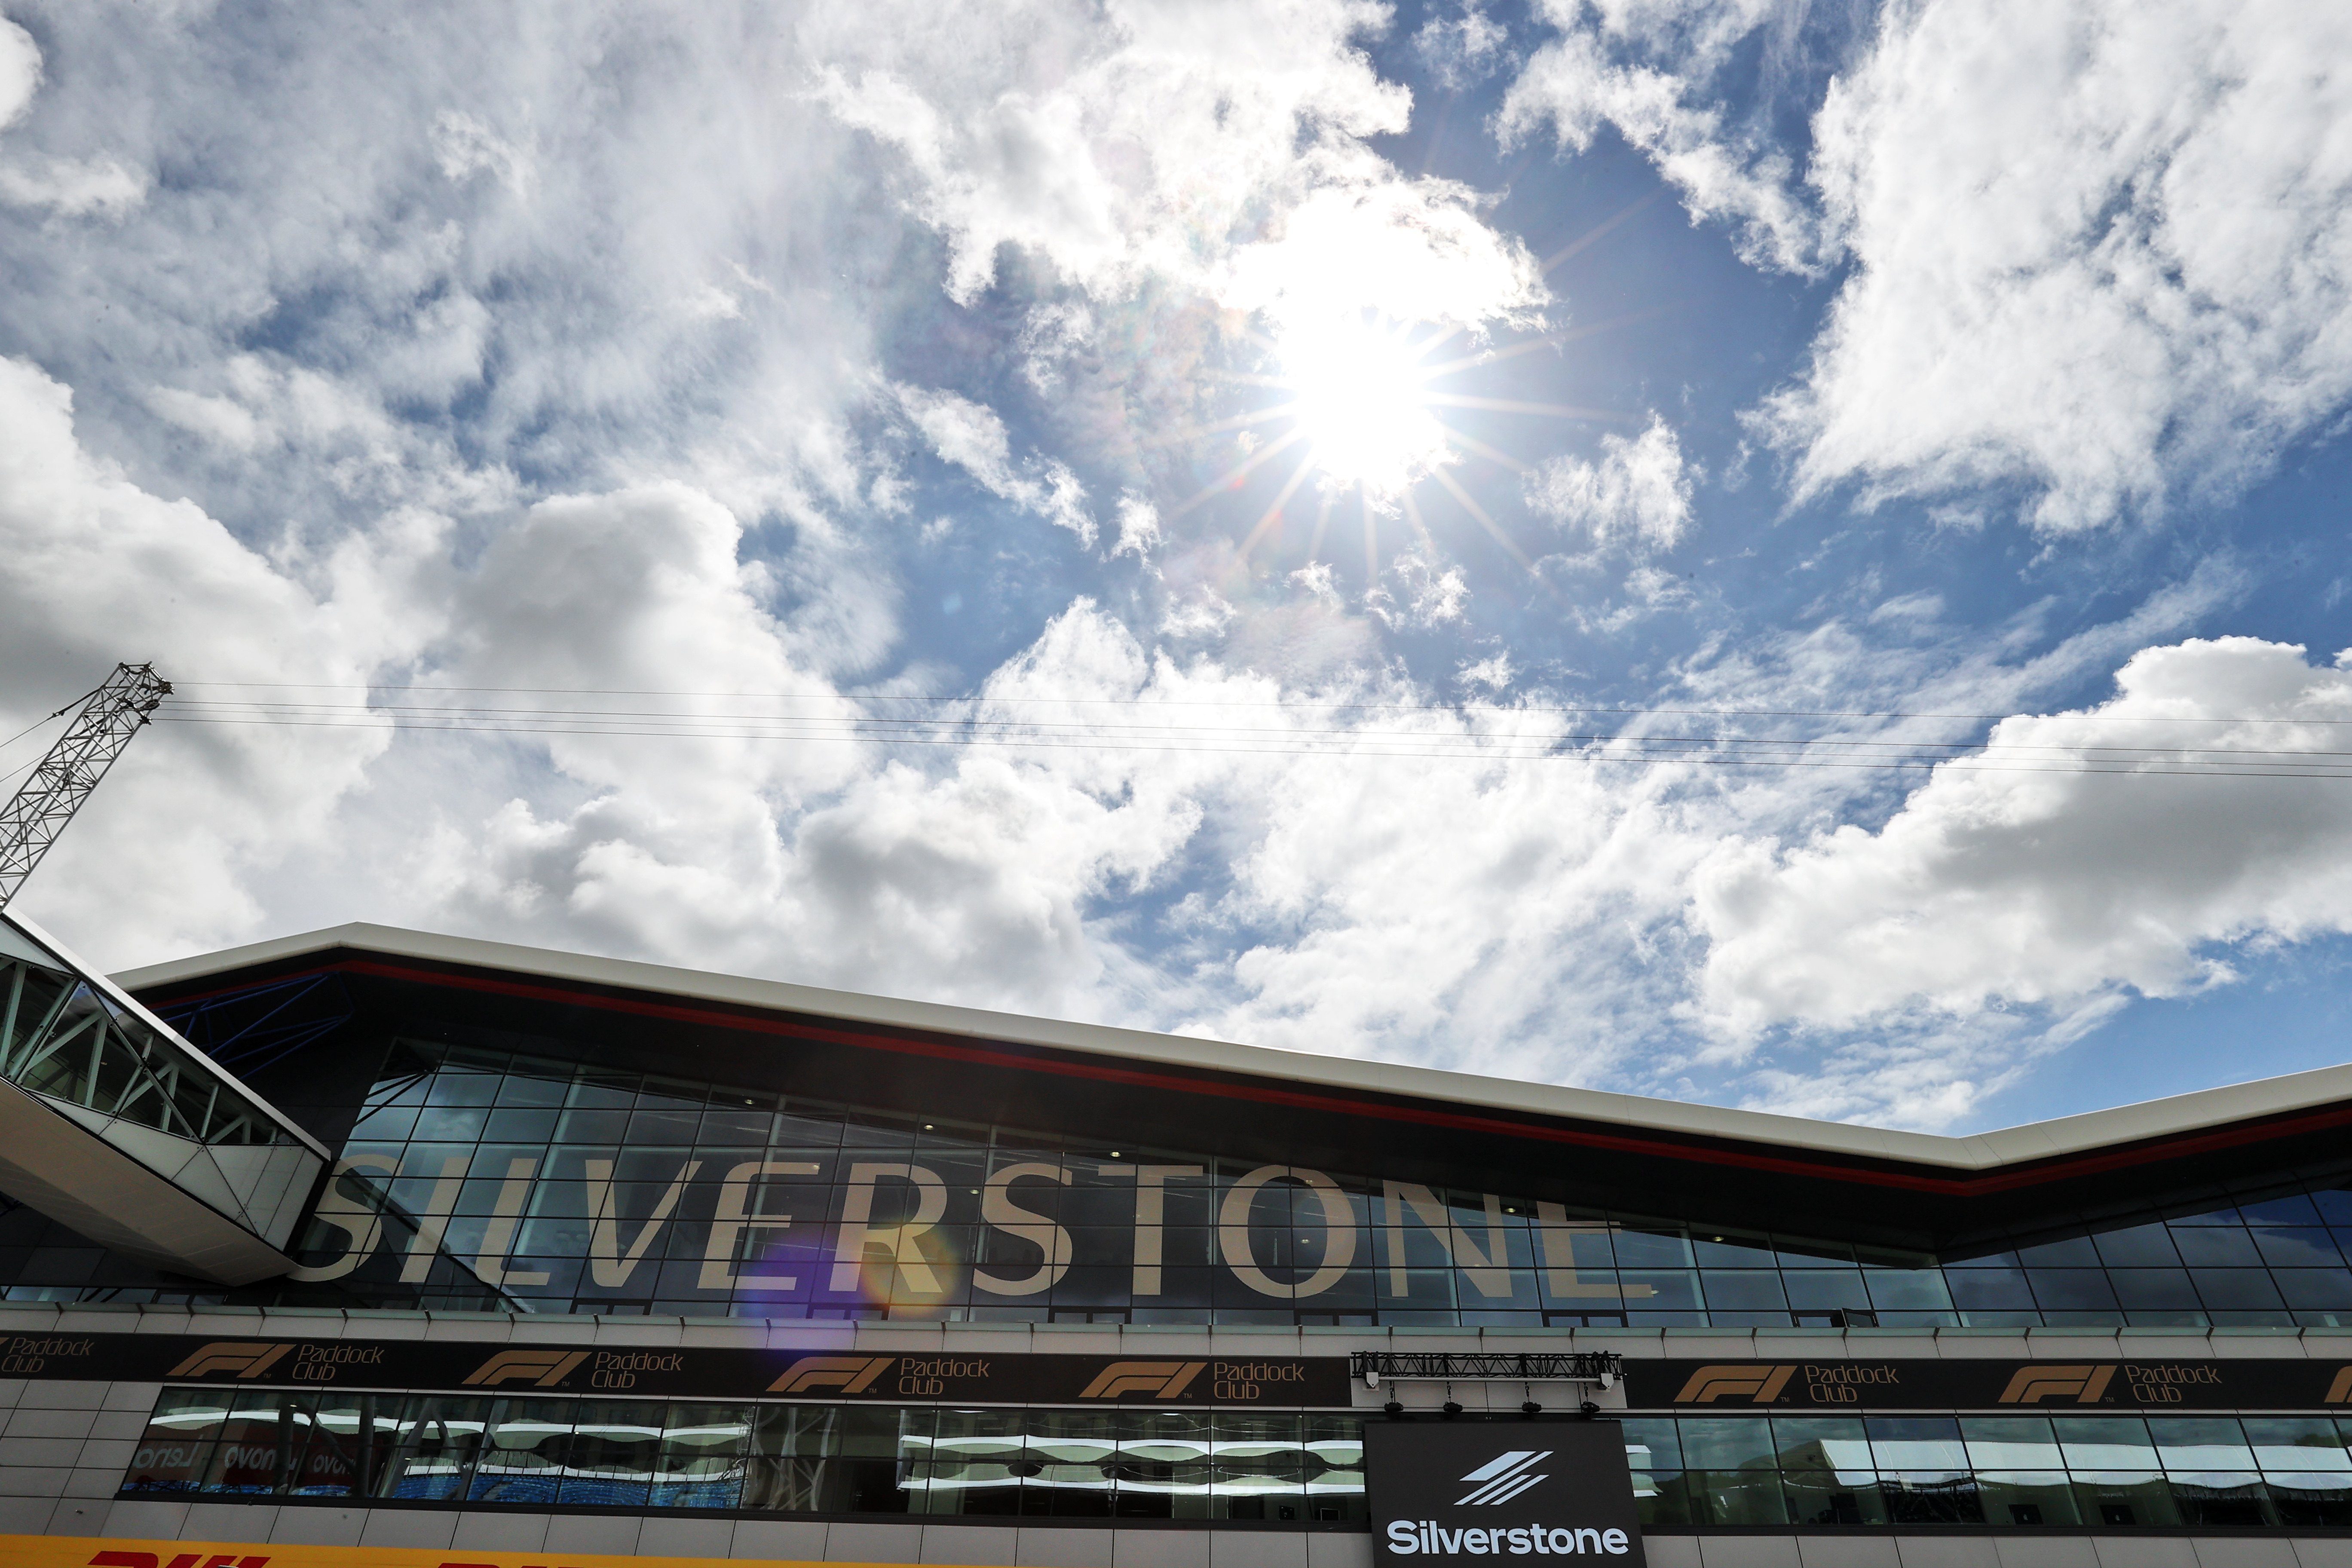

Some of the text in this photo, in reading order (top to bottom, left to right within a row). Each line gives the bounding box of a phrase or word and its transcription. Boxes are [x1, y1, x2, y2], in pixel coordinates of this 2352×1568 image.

[287, 1154, 1654, 1298] SILVERSTONE
[8, 1337, 95, 1356] Paddock
[297, 1344, 385, 1363] Paddock
[1, 1354, 45, 1372] Club
[292, 1362, 336, 1380] Club
[594, 1352, 684, 1371] Paddock
[901, 1358, 991, 1378] Paddock
[591, 1370, 636, 1388] Club
[1214, 1362, 1305, 1381] Paddock
[1804, 1365, 1900, 1384] Paddock
[2124, 1365, 2222, 1384] Paddock
[898, 1376, 943, 1395] Club
[1214, 1380, 1260, 1400] Club
[1809, 1383, 1858, 1403] Club
[2133, 1383, 2182, 1403] Club
[1387, 1520, 1629, 1555] Silverstone
